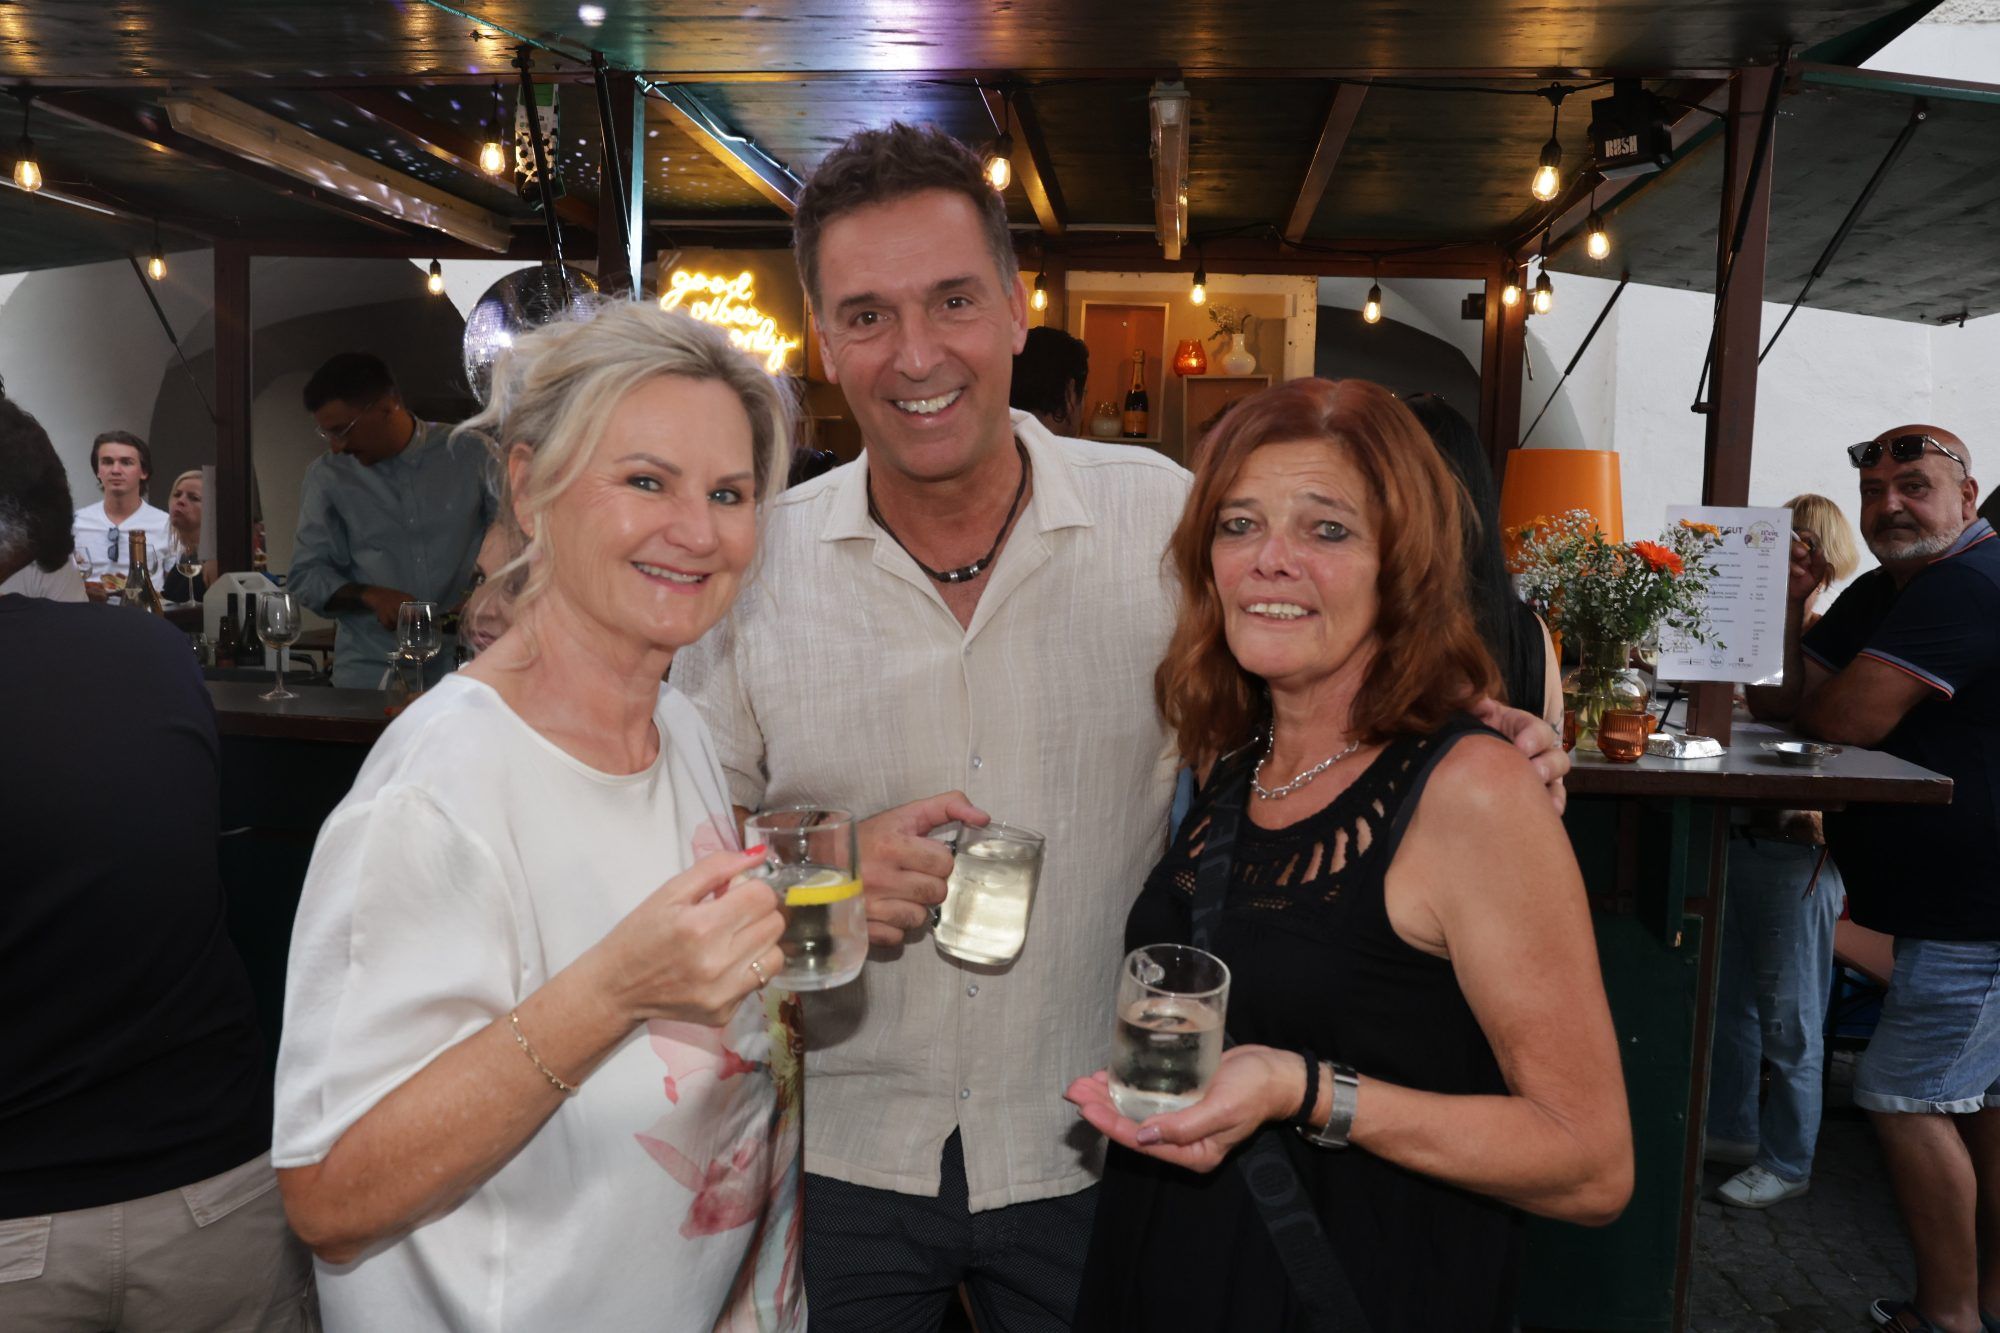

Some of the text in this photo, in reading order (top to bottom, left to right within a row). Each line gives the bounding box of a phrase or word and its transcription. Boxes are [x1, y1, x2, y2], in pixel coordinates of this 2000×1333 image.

[1605, 135, 1637, 157] RUSH
[660, 271, 753, 311] good
[691, 297, 763, 326] vibes
[729, 319, 797, 371] only
